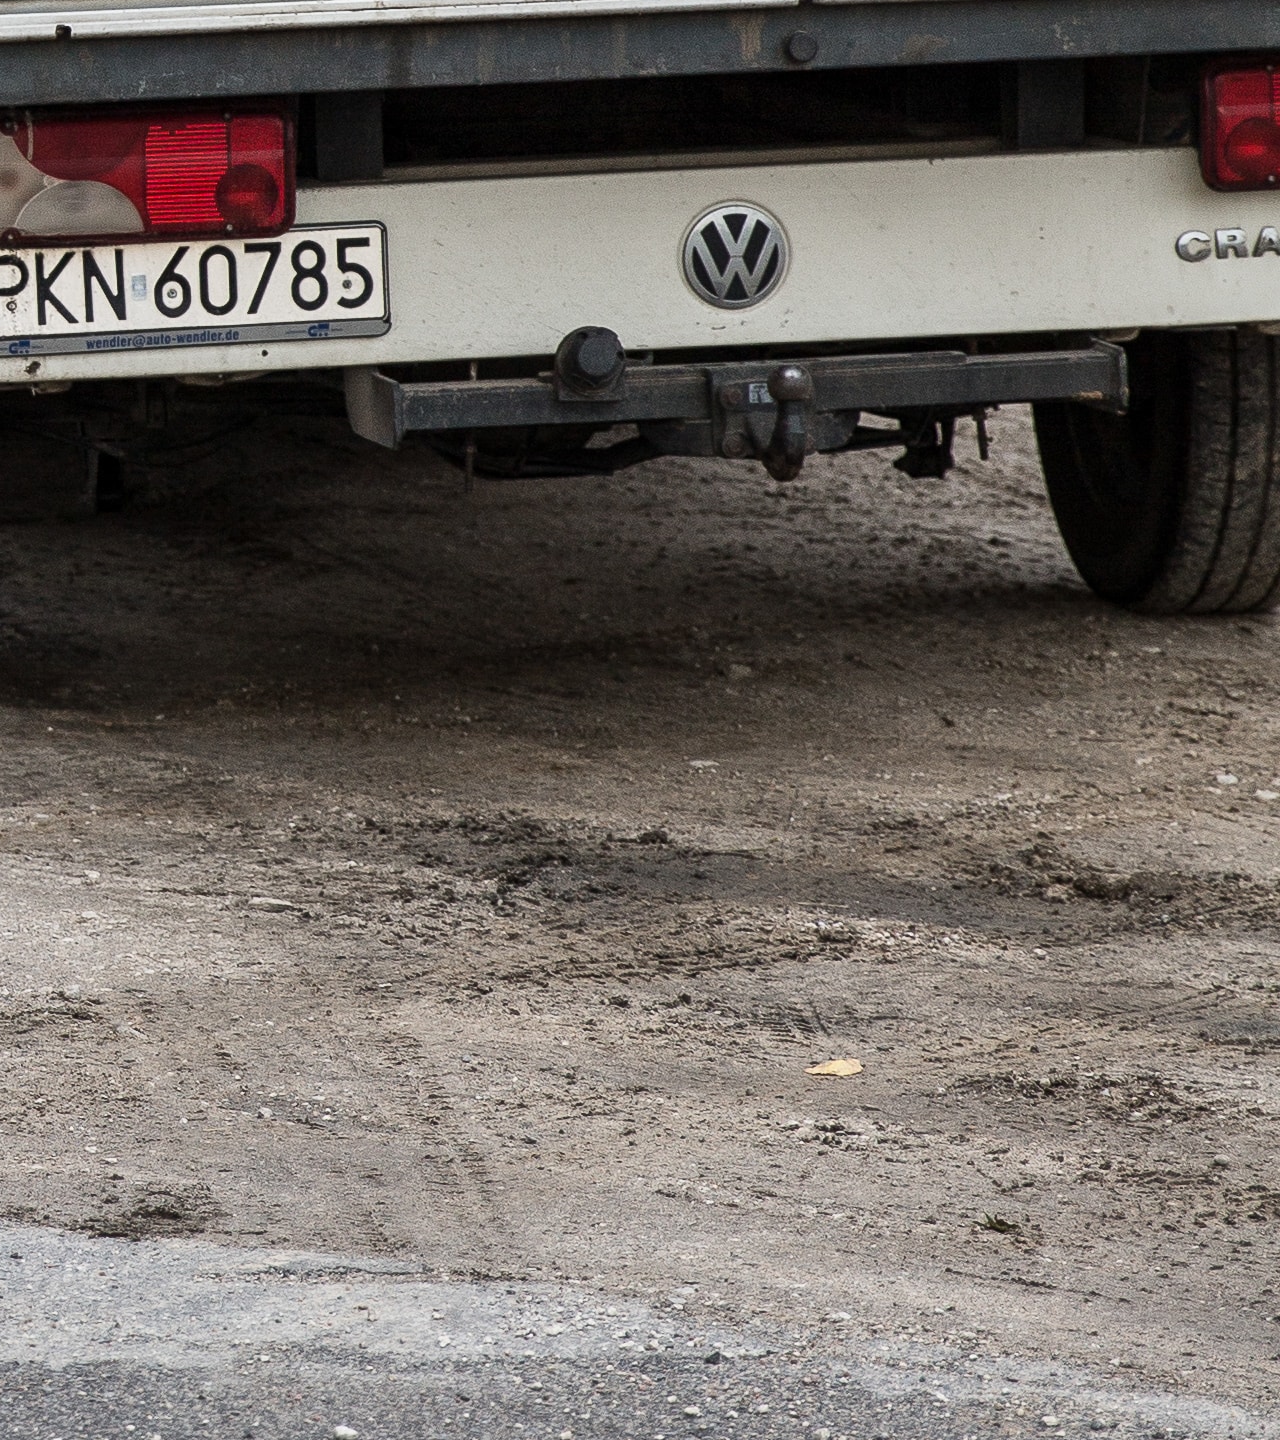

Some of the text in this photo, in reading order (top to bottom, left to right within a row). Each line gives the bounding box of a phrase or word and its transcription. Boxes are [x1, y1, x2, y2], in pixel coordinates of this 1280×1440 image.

[685, 207, 785, 306] VW
[1175, 226, 1280, 262] CRA
[153, 237, 374, 318] 60785
[85, 329, 240, 350] wendler@auto-wendler.de
